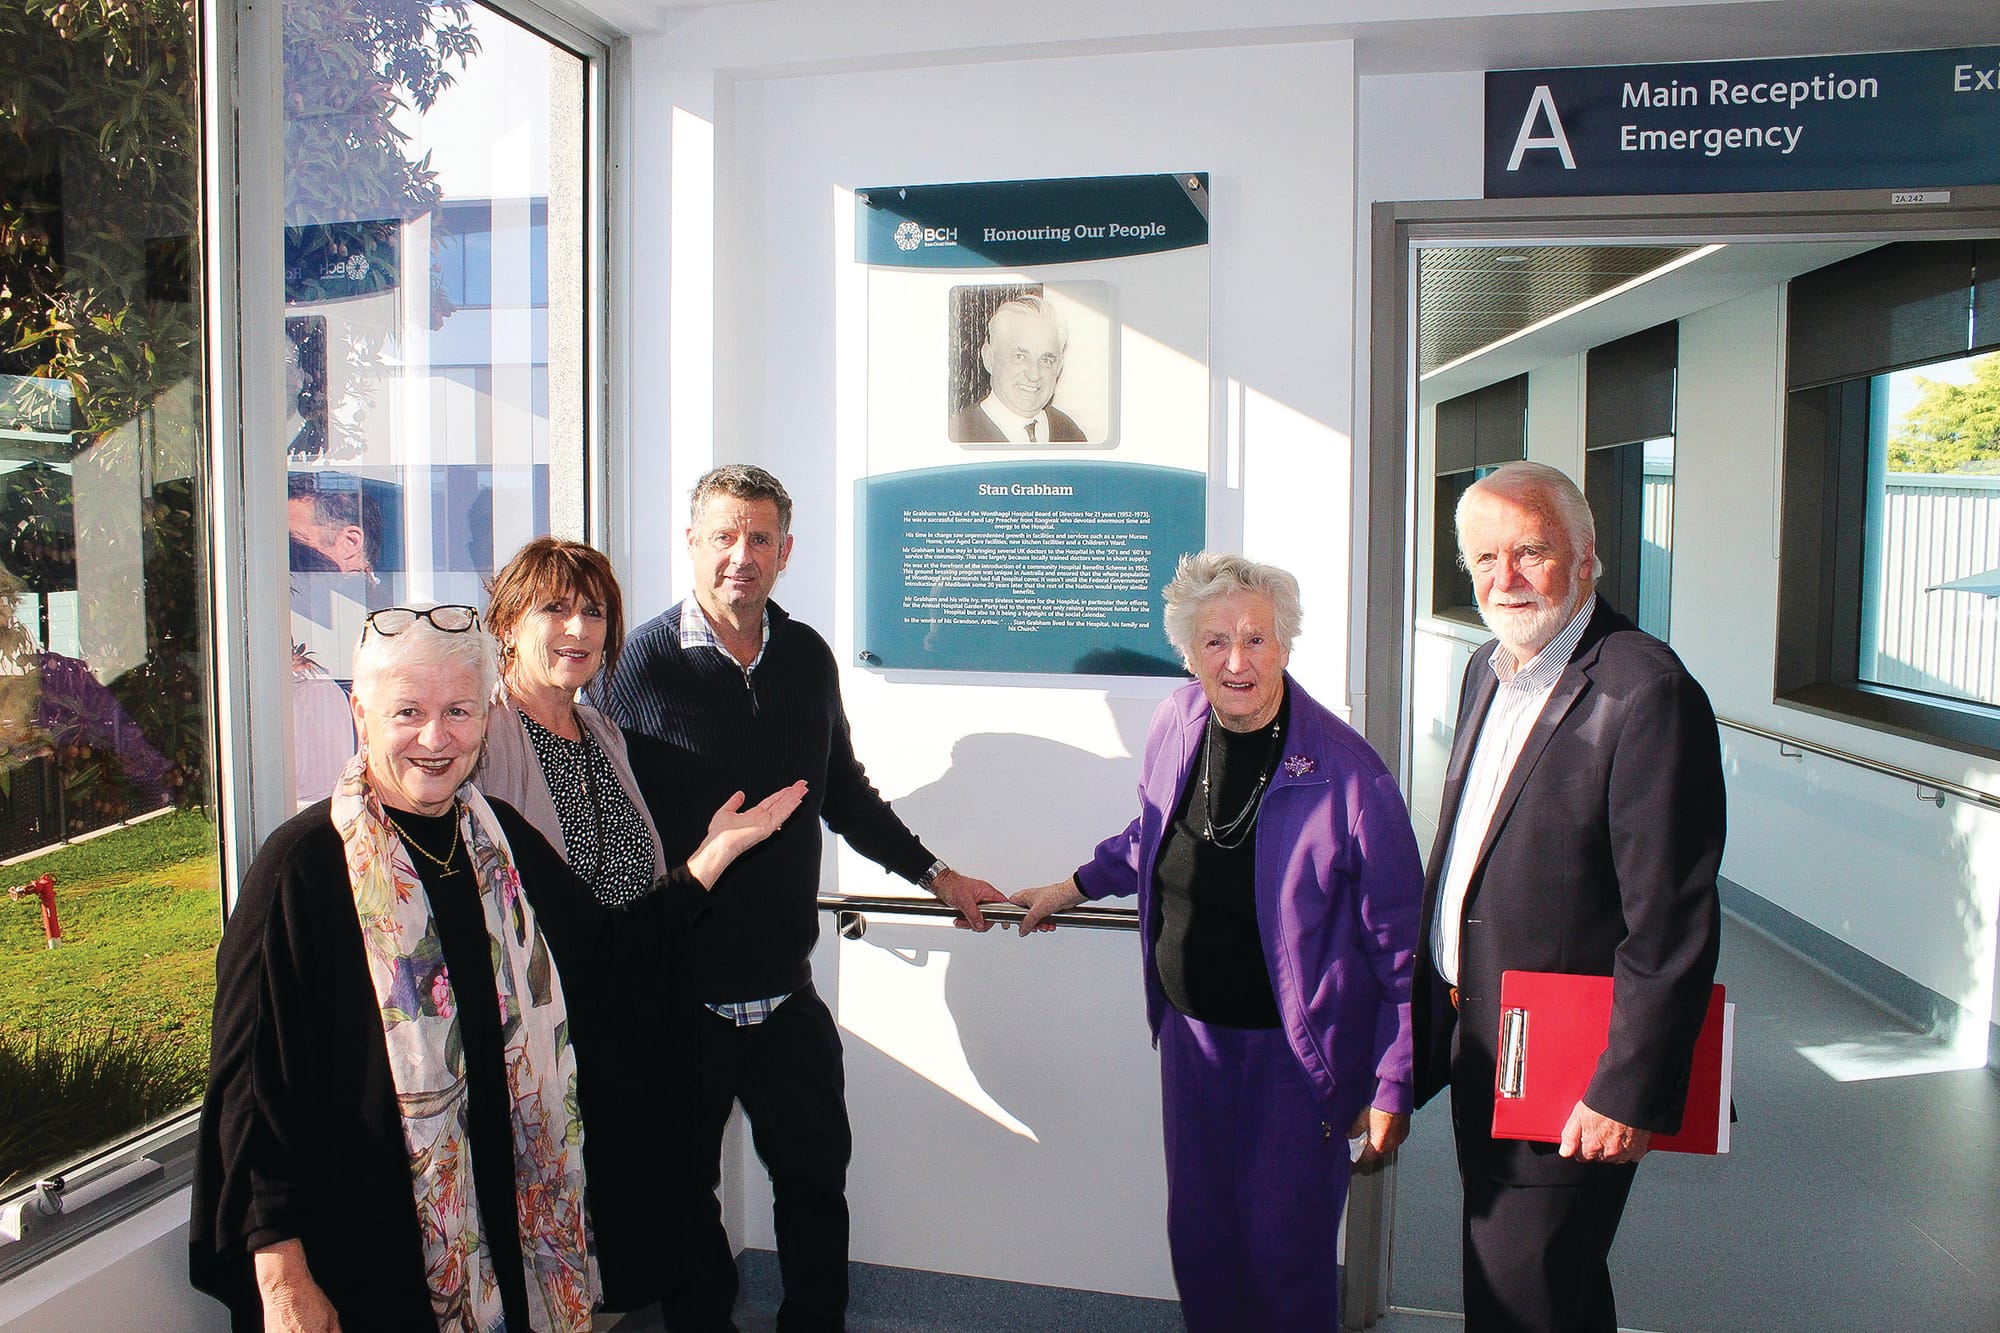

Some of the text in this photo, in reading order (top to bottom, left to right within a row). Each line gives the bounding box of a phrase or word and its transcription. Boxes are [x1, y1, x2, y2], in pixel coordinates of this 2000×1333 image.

[1621, 72, 1879, 110] Main Reception
[1506, 85, 1577, 171] A
[1620, 125, 1803, 157] Emergency
[924, 227, 958, 242] BCH
[983, 222, 1166, 243] Honouring Our People
[978, 484, 1074, 496] Stan Grabham
[1011, 511, 1034, 519] Hospital
[934, 532, 952, 540] charge
[989, 554, 1007, 562] largely
[1027, 564, 1057, 572] community
[1058, 564, 1081, 572] Hospital
[1120, 571, 1151, 579] population
[941, 603, 963, 611] Hospital
[1066, 605, 1084, 613] raising
[944, 609, 966, 617] Hospital
[1001, 610, 1016, 618] being
